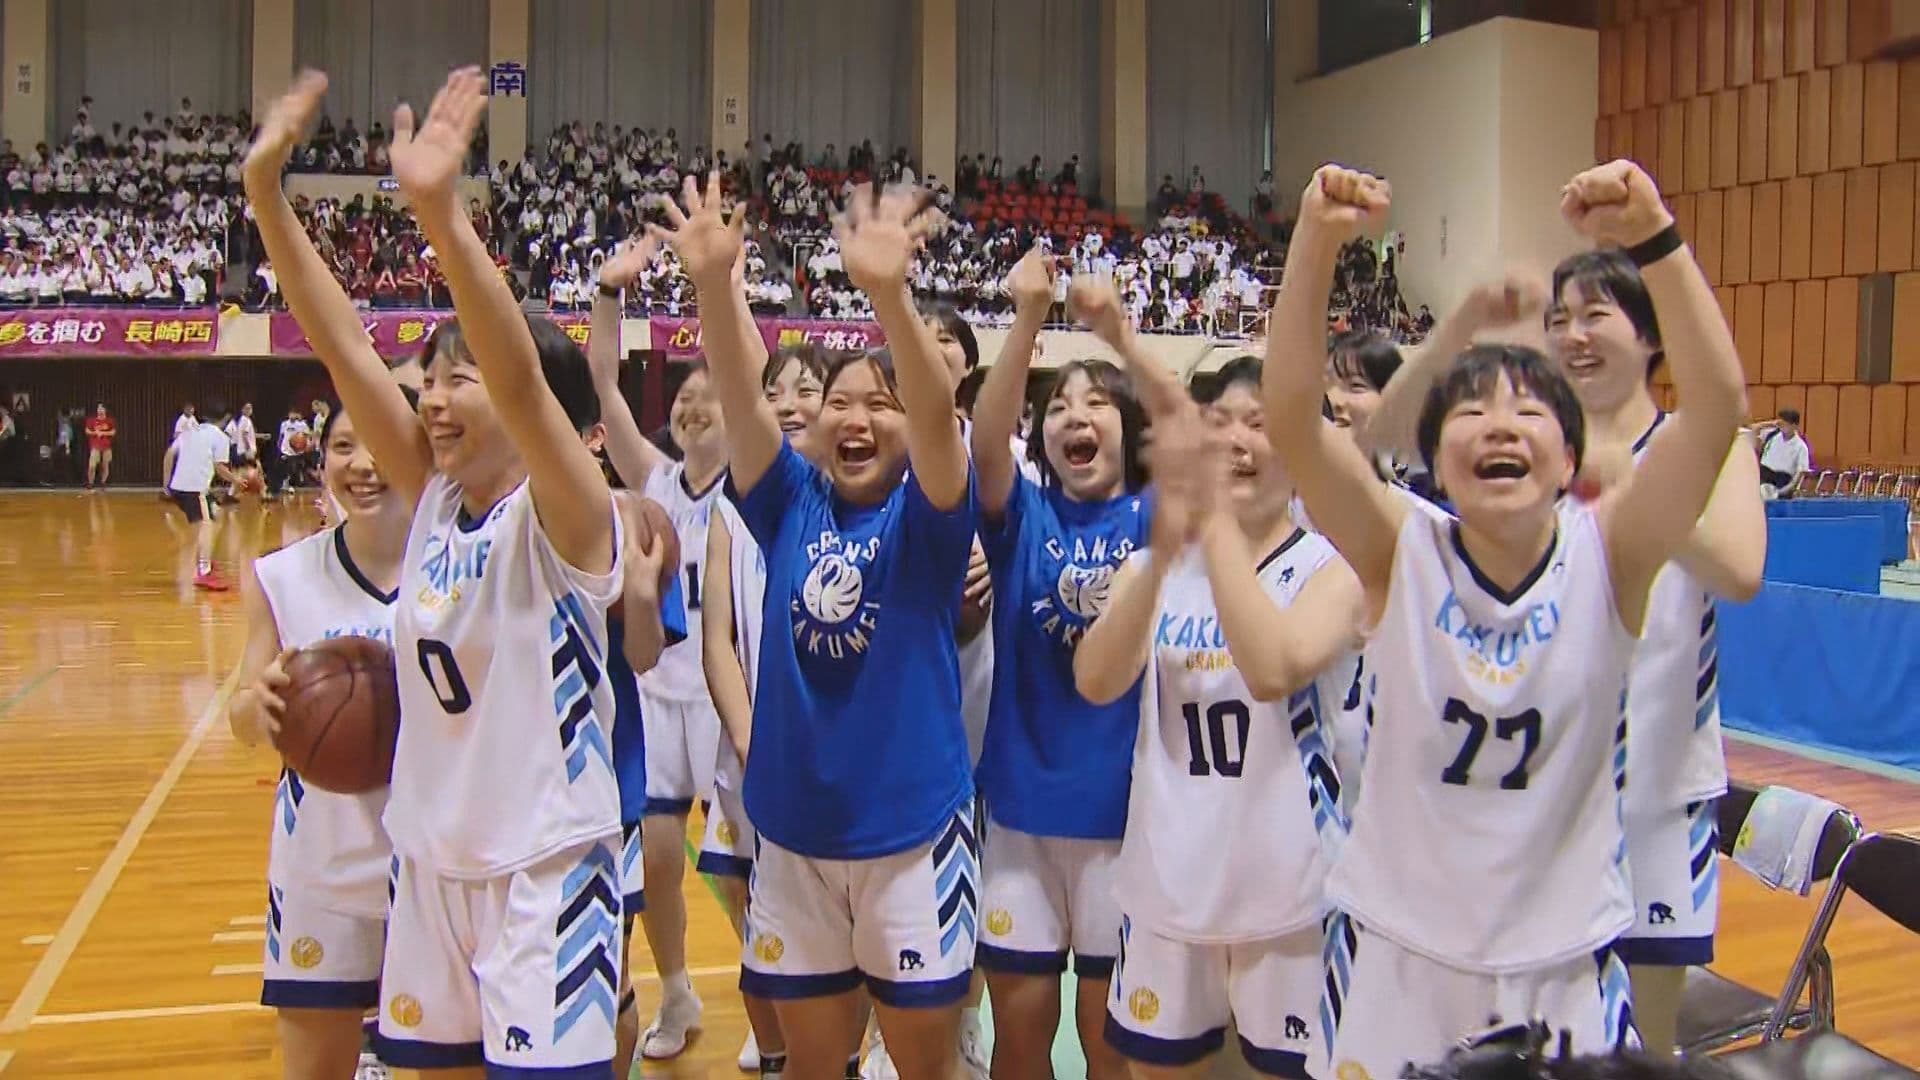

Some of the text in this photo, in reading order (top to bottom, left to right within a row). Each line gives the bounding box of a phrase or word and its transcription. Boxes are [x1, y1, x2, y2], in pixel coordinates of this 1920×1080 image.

[490, 62, 526, 97] 南
[124, 320, 213, 343] 長崎西
[417, 638, 473, 715] 0
[1182, 699, 1251, 777] 10
[1441, 696, 1542, 790] 77
